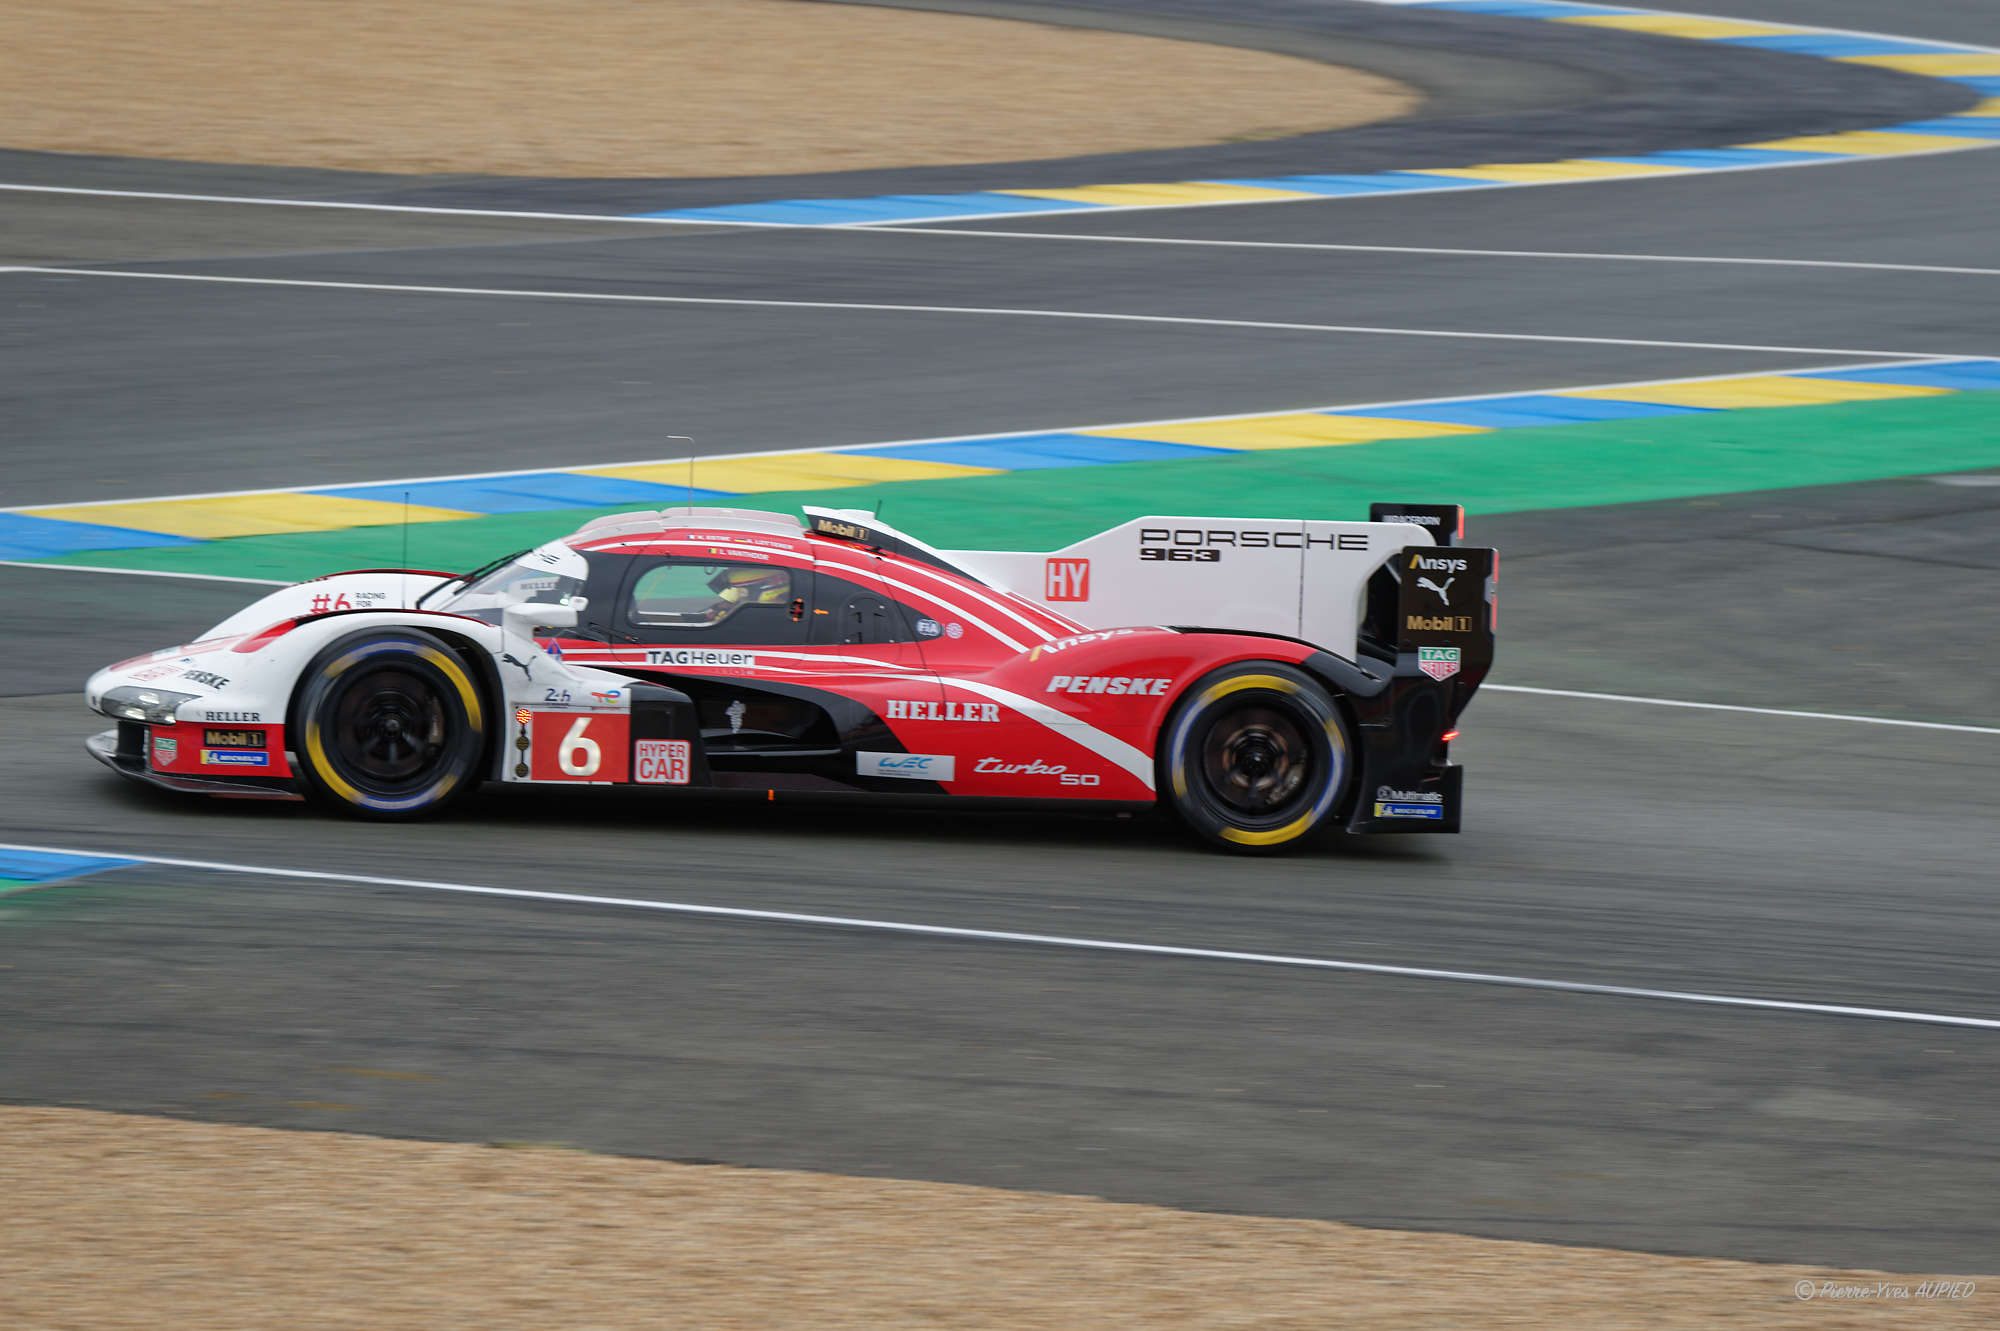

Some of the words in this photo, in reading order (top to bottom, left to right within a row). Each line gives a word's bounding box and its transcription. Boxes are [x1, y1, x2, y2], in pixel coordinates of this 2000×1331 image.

[817, 519, 856, 539] Mobil
[1140, 528, 1369, 551] PORSCHE
[1140, 549, 1220, 562] 963
[1408, 554, 1469, 574] Ansys
[1048, 562, 1087, 598] HY
[1407, 615, 1453, 631] Mobil
[1029, 628, 1135, 662] Ansys
[1422, 649, 1457, 660] TAG
[1046, 675, 1173, 696] PENSKE
[205, 711, 262, 723] HELLER
[886, 699, 1001, 723] HELLER
[206, 731, 246, 746] Mobil
[558, 717, 602, 777] 6
[639, 743, 686, 758] HYPER
[639, 757, 685, 780] CAR
[877, 756, 934, 770] WEC
[973, 756, 1067, 775] turbo
[1060, 773, 1100, 786] 50
